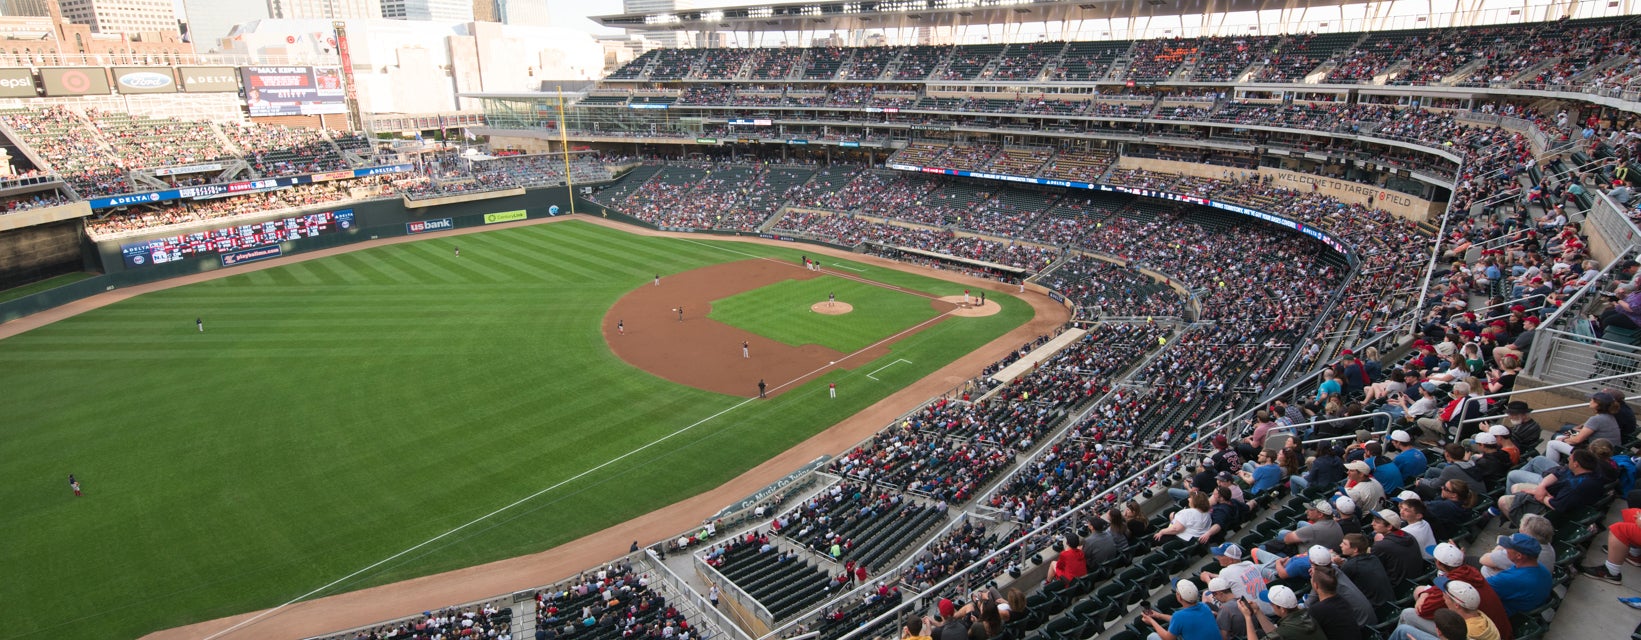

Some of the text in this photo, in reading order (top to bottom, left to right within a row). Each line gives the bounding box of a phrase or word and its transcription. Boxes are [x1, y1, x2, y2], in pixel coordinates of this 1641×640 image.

[0, 76, 31, 88] epsi
[131, 74, 161, 86] Ford
[1278, 172, 1411, 207] WELCOME TO TARGET FIELD
[118, 196, 147, 204] DELTA
[497, 212, 523, 220] CenturyLink
[742, 469, 810, 509] Go Music Go Twins
